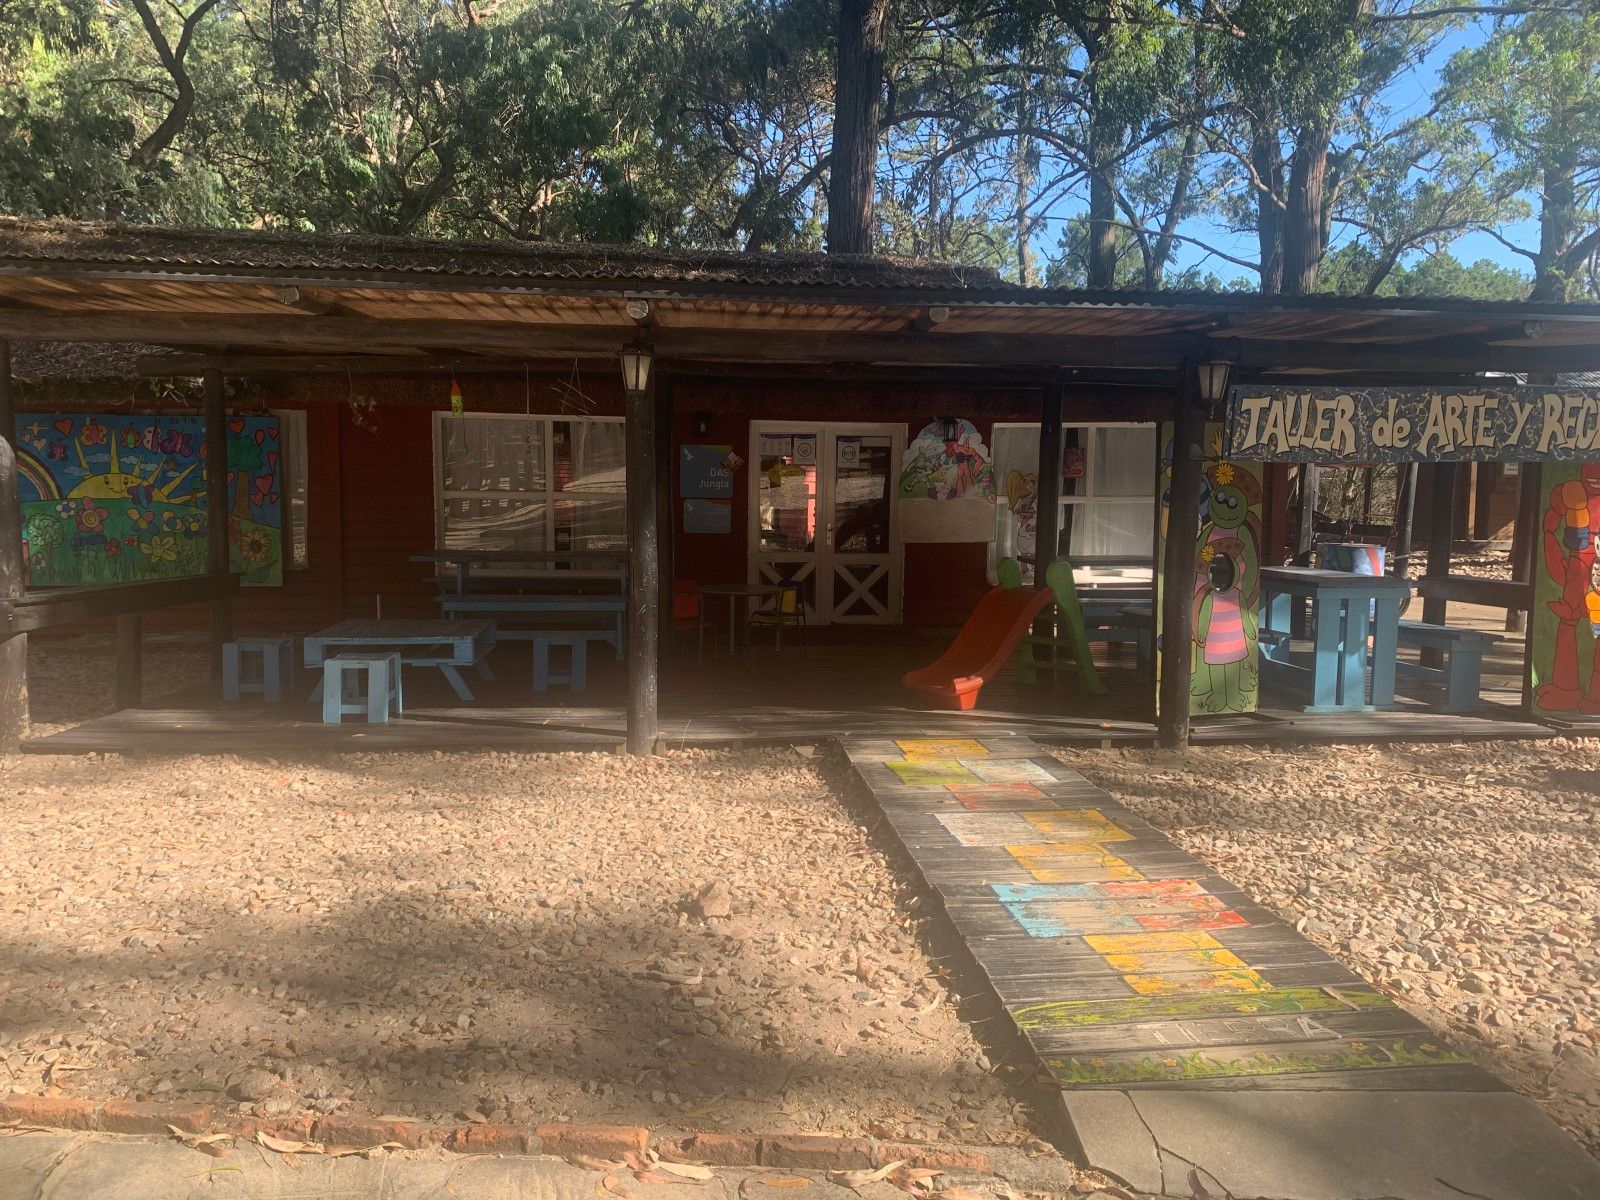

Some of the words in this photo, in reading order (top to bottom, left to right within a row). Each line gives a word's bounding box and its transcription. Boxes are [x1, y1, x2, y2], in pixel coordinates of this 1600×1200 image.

[1240, 393, 1359, 457] TALLER
[1371, 397, 1411, 448] de
[1417, 394, 1500, 457] ARTE
[711, 467, 730, 477] DAS
[1136, 1016, 1343, 1046] TIERRA
